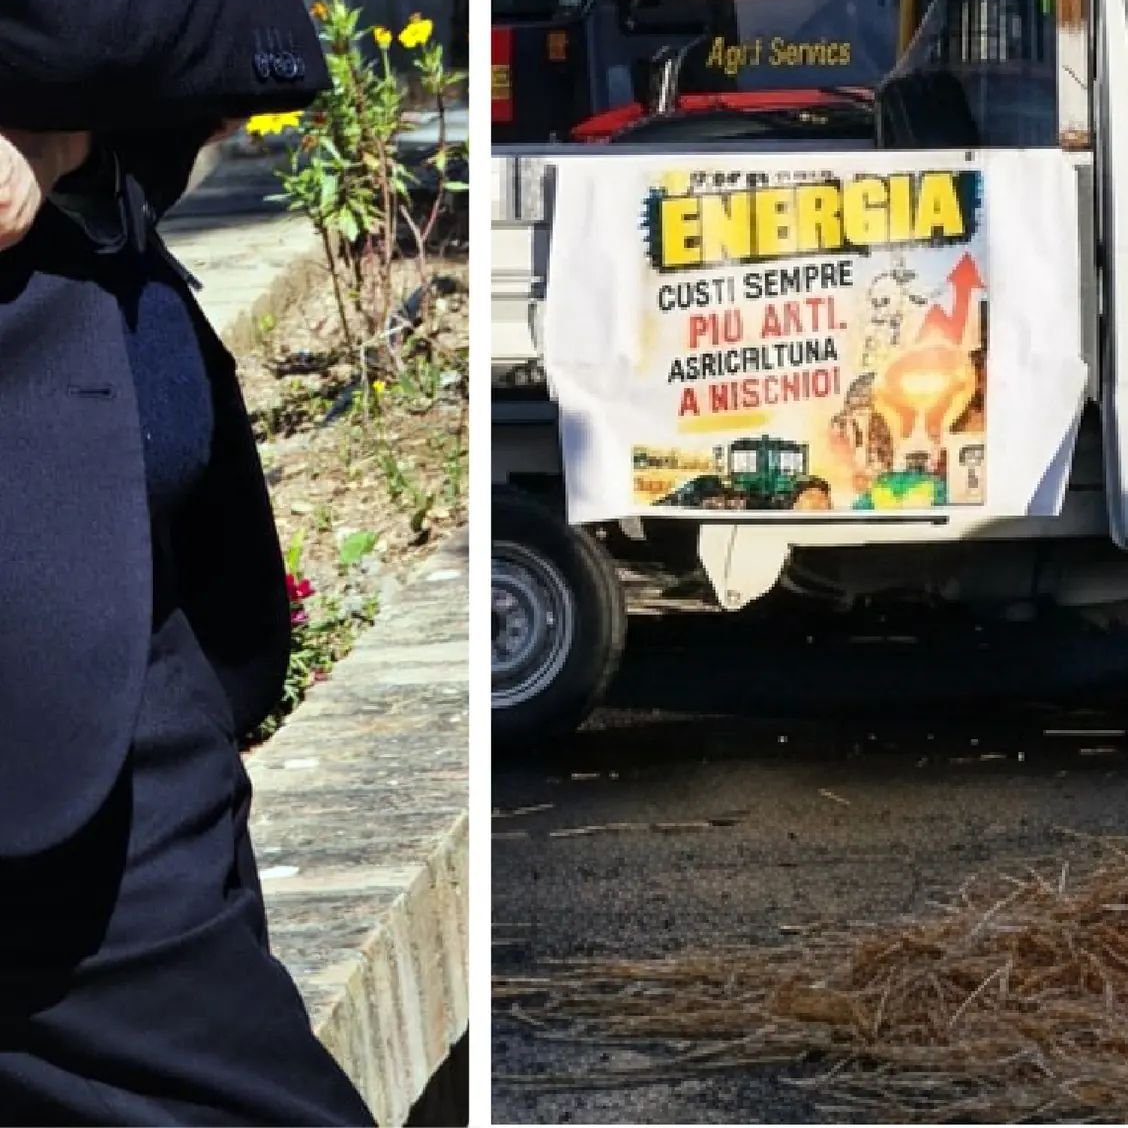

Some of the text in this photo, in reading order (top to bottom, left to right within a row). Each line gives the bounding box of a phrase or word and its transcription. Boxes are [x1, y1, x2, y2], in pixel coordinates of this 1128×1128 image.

[660, 171, 964, 268] ENERGIA
[743, 260, 853, 300] SEMPRE
[678, 387, 700, 417] A
